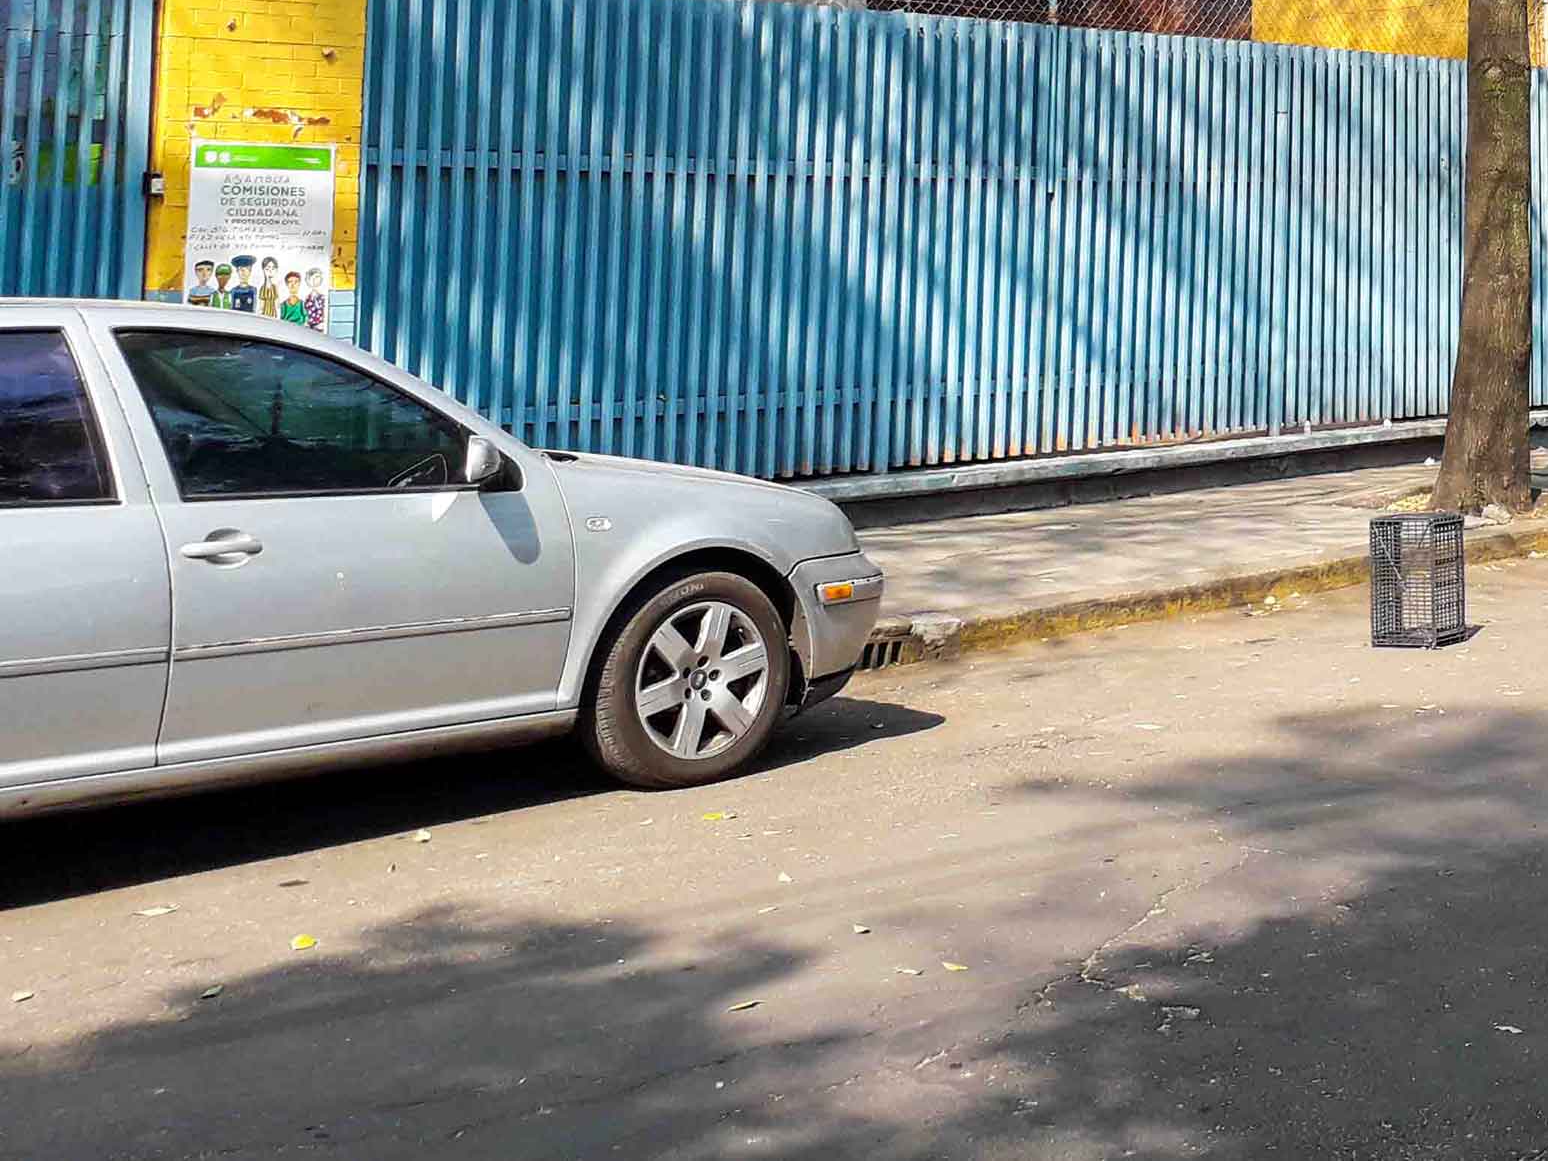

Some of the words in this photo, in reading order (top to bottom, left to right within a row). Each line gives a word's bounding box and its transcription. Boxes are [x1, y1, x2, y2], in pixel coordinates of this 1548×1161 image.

[220, 185, 306, 197] COMISIONES
[220, 197, 237, 206] DE
[240, 197, 306, 207] SEGURIDAD
[226, 208, 299, 217] CIUDADANA
